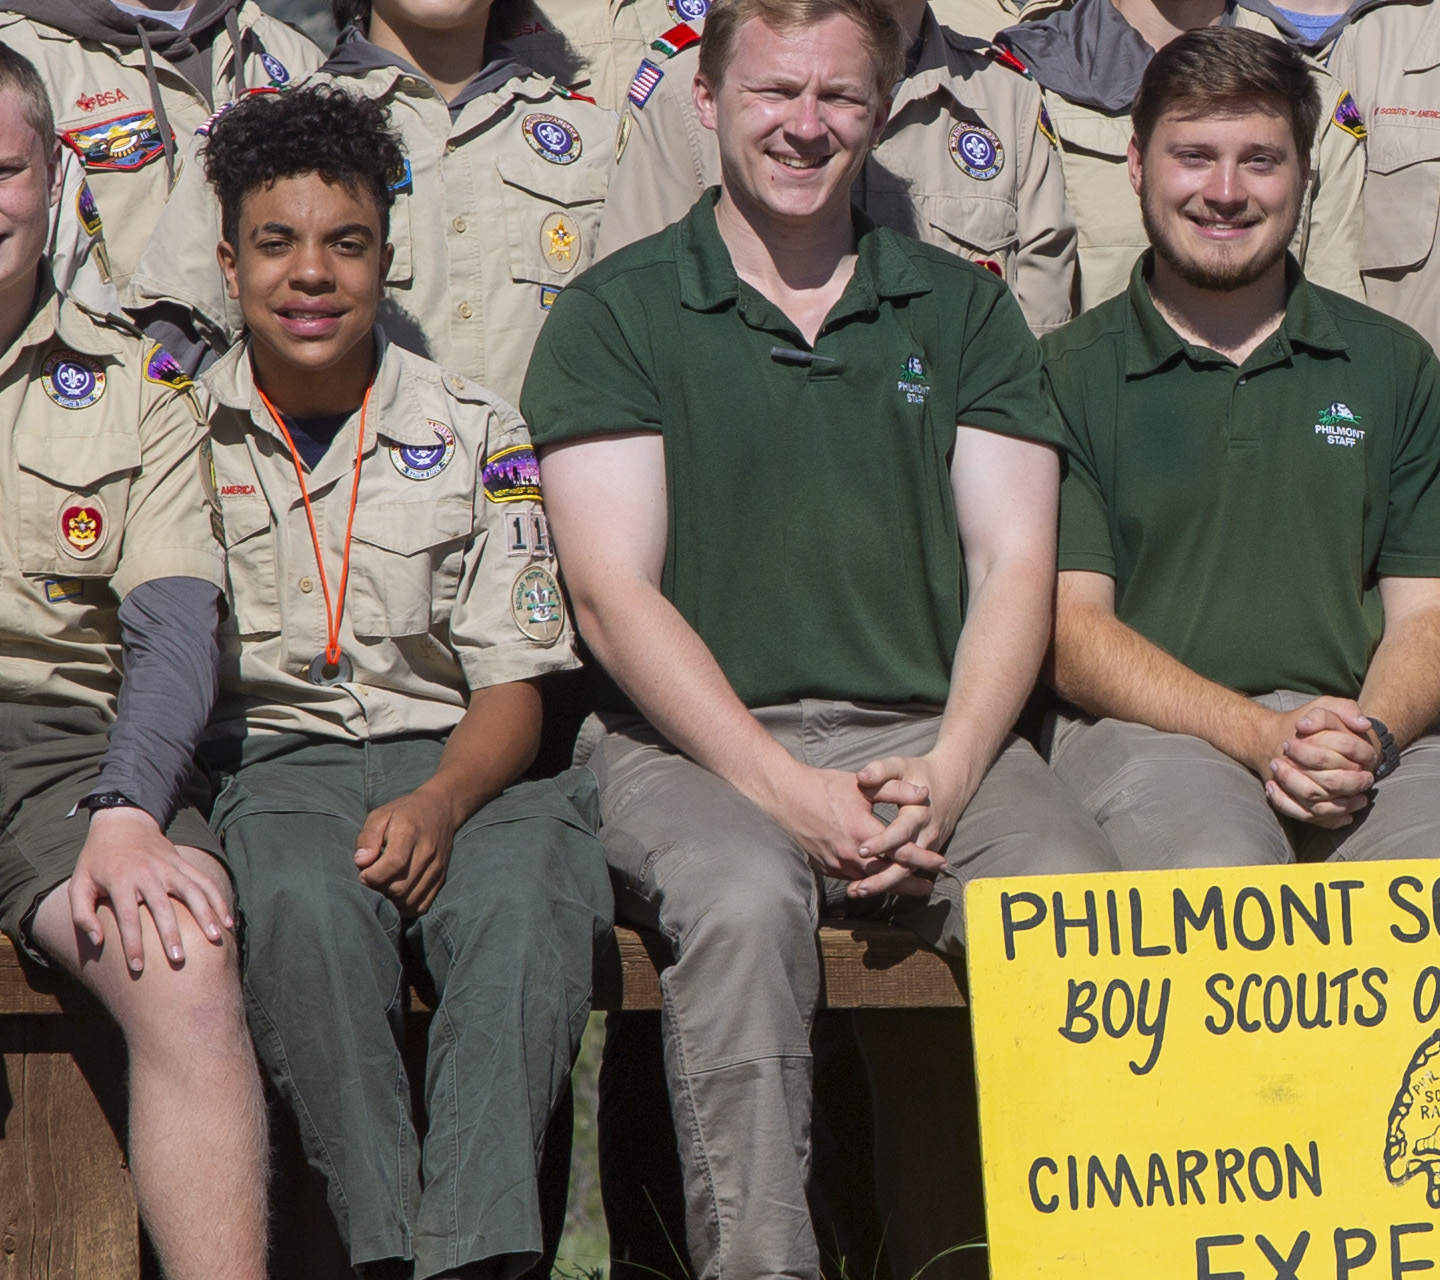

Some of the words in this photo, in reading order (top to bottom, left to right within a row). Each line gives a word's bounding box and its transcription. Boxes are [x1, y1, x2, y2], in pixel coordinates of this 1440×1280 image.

[95, 88, 129, 107] BSA
[1314, 424, 1366, 440] PHILMONT
[1327, 434, 1357, 448] STAFF
[220, 484, 257, 496] AMERICA
[1001, 881, 1364, 960] PHILMONT
[1205, 968, 1387, 1035] SCOUTS
[1029, 1141, 1321, 1213] CIMARRON
